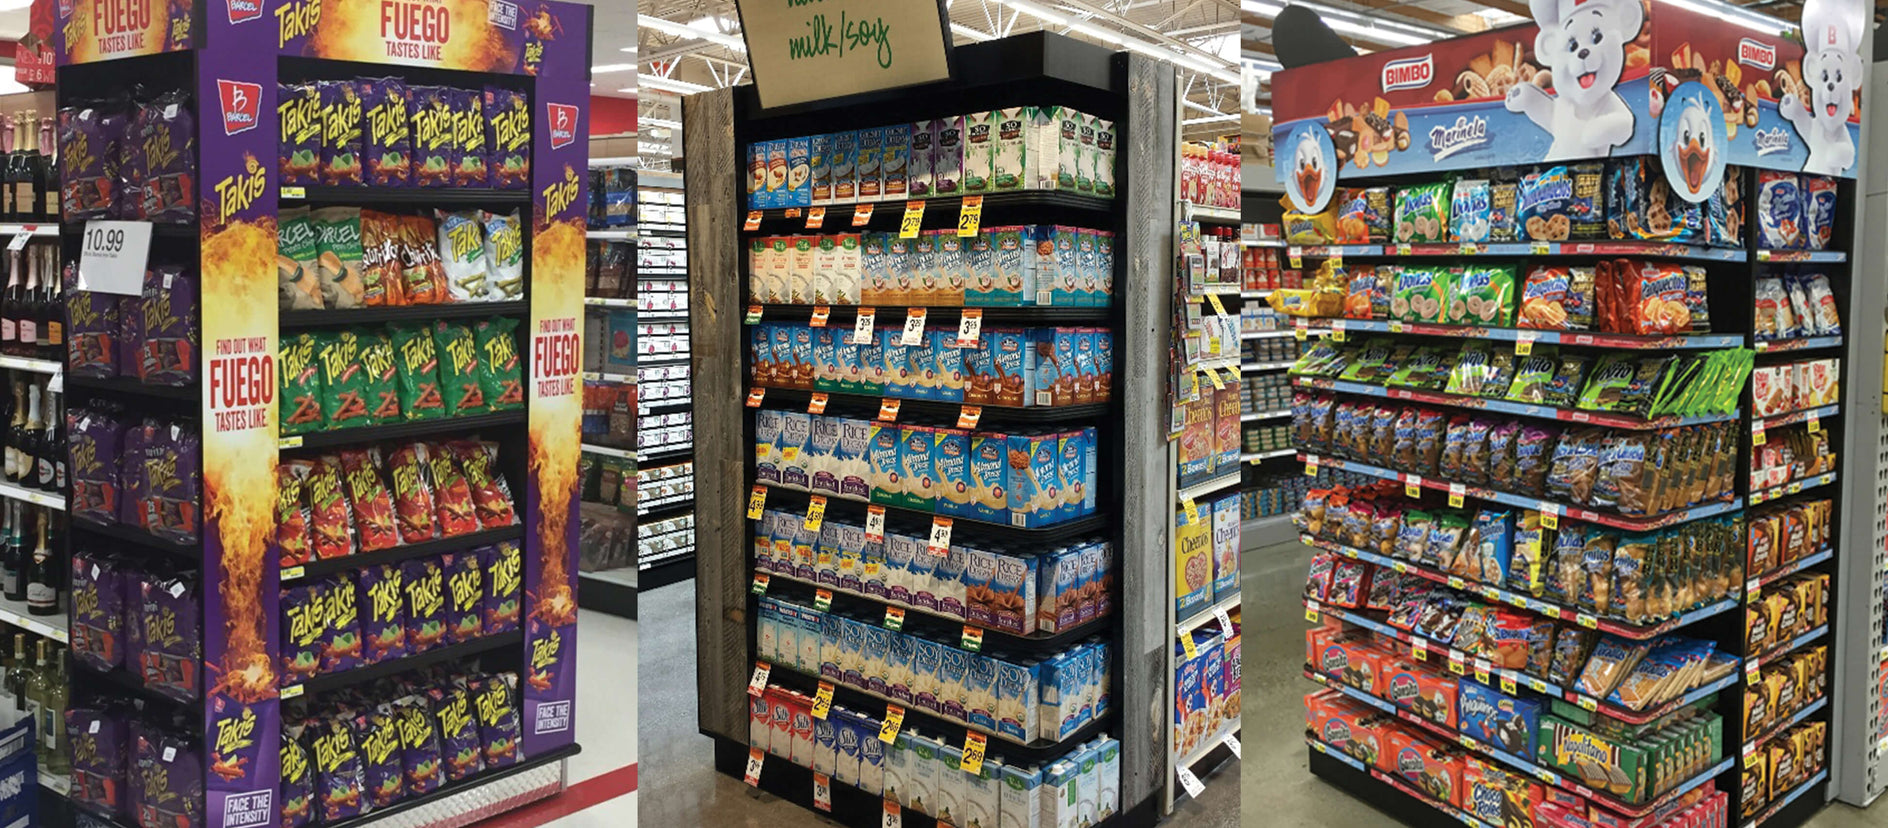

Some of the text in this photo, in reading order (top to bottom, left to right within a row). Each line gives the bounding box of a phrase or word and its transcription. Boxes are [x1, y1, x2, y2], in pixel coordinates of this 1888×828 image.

[94, 0, 151, 36] FUEGO
[275, 0, 320, 48] Takis
[380, 1, 450, 44] FUEGO
[97, 36, 126, 54] TASTES
[385, 41, 420, 59] TASTES
[789, 10, 892, 69] milk/soy
[1741, 42, 1775, 66] BIMBO
[1385, 62, 1430, 86] BIMBO
[226, 111, 254, 123] BARCEL
[277, 91, 321, 145] Takis
[320, 97, 361, 148] Takis
[367, 99, 407, 146] Takis
[411, 104, 450, 150] Takis
[491, 103, 529, 151] Takis
[1430, 117, 1487, 150] Marinela
[1756, 129, 1789, 148] Marinela
[214, 162, 266, 225] Takis
[543, 171, 579, 224] Takis
[86, 229, 124, 252] 10.99
[1641, 275, 1686, 299] Panquecitos
[540, 319, 551, 331] FIND
[216, 337, 266, 355] FIND OUT WHAT
[534, 334, 580, 378] FUEGO
[279, 337, 316, 388] Takis
[319, 334, 357, 386] Takis
[1521, 357, 1553, 376] Nito
[1600, 362, 1633, 381] Nito
[210, 355, 273, 409] FUEGO
[537, 379, 560, 398] TASTES
[215, 410, 246, 432] TASTES
[815, 420, 838, 434] RICE
[843, 424, 867, 439] RICE
[347, 461, 377, 503] Takis
[890, 538, 911, 553] RICE
[1182, 533, 1208, 555] Cheerios
[970, 553, 994, 568] RICE
[998, 558, 1022, 576] RICE
[489, 549, 520, 597] Takis
[368, 569, 402, 622] Takis
[405, 568, 442, 618] Takis
[287, 597, 323, 644] Takis
[918, 642, 941, 661] SOY
[945, 648, 968, 668] SOY
[971, 655, 996, 677] SOY
[1001, 667, 1025, 686] SOY
[1389, 681, 1419, 700] Gansito
[437, 693, 468, 739] Takis
[475, 684, 507, 727] Takis
[538, 704, 568, 720] FACE THE
[215, 714, 256, 752] Takis
[396, 708, 425, 750] Takis
[838, 728, 858, 747] Silk
[313, 728, 350, 773] Takis
[362, 718, 396, 767] Takis
[1563, 735, 1608, 764] Napolitano
[1473, 782, 1502, 802] Choco
[228, 795, 269, 814] FACE THE
[1476, 799, 1502, 818] Roles
[226, 810, 269, 827] INTENSITY
